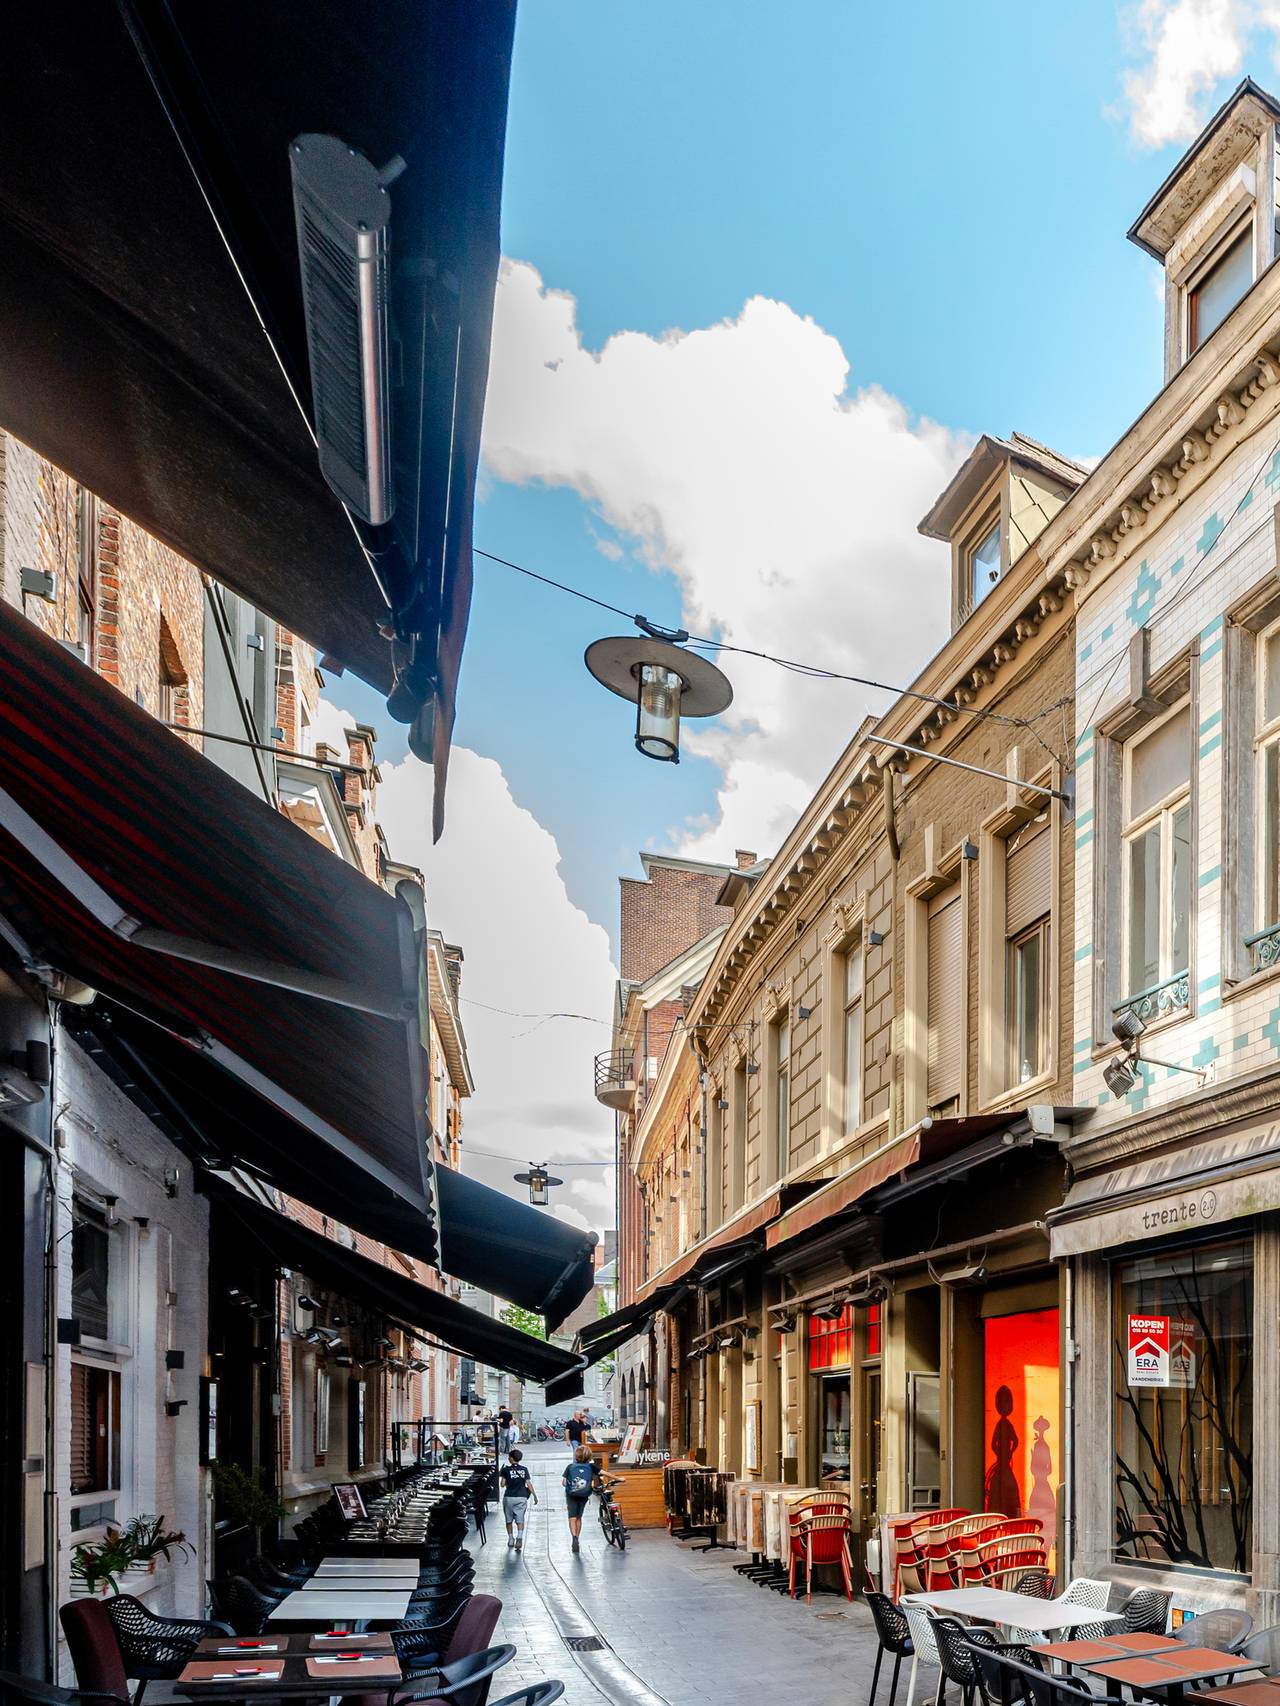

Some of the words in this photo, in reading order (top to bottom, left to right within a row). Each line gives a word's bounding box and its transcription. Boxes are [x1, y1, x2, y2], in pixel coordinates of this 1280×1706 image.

[1142, 1202, 1196, 1229] trente
[1131, 1320, 1164, 1328] KOPEN
[1136, 1358, 1159, 1368] ERA
